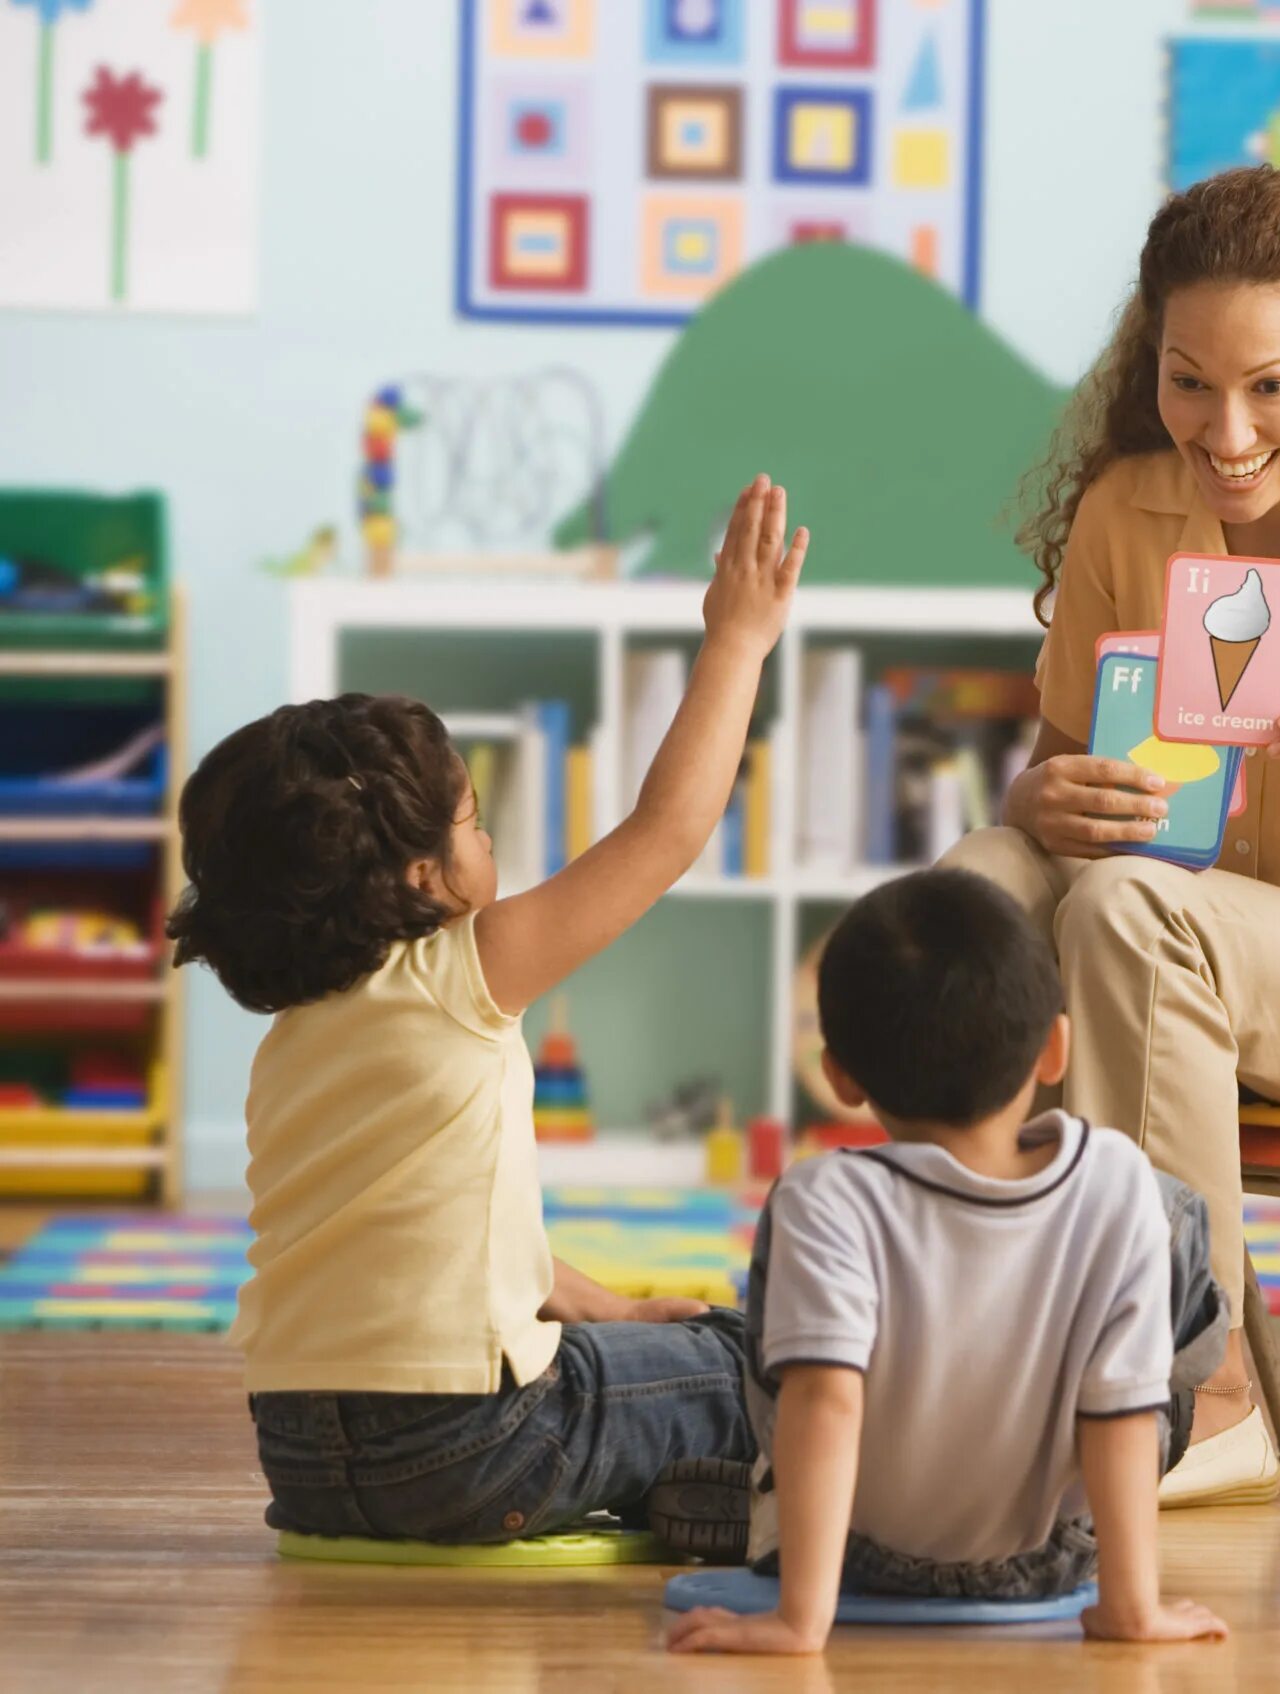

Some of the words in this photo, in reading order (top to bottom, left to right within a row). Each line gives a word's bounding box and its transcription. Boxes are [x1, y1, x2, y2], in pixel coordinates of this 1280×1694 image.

[1187, 567, 1210, 594] Ii
[1112, 666, 1143, 693] Ff
[1178, 706, 1205, 726] ice
[1211, 714, 1275, 731] cream
